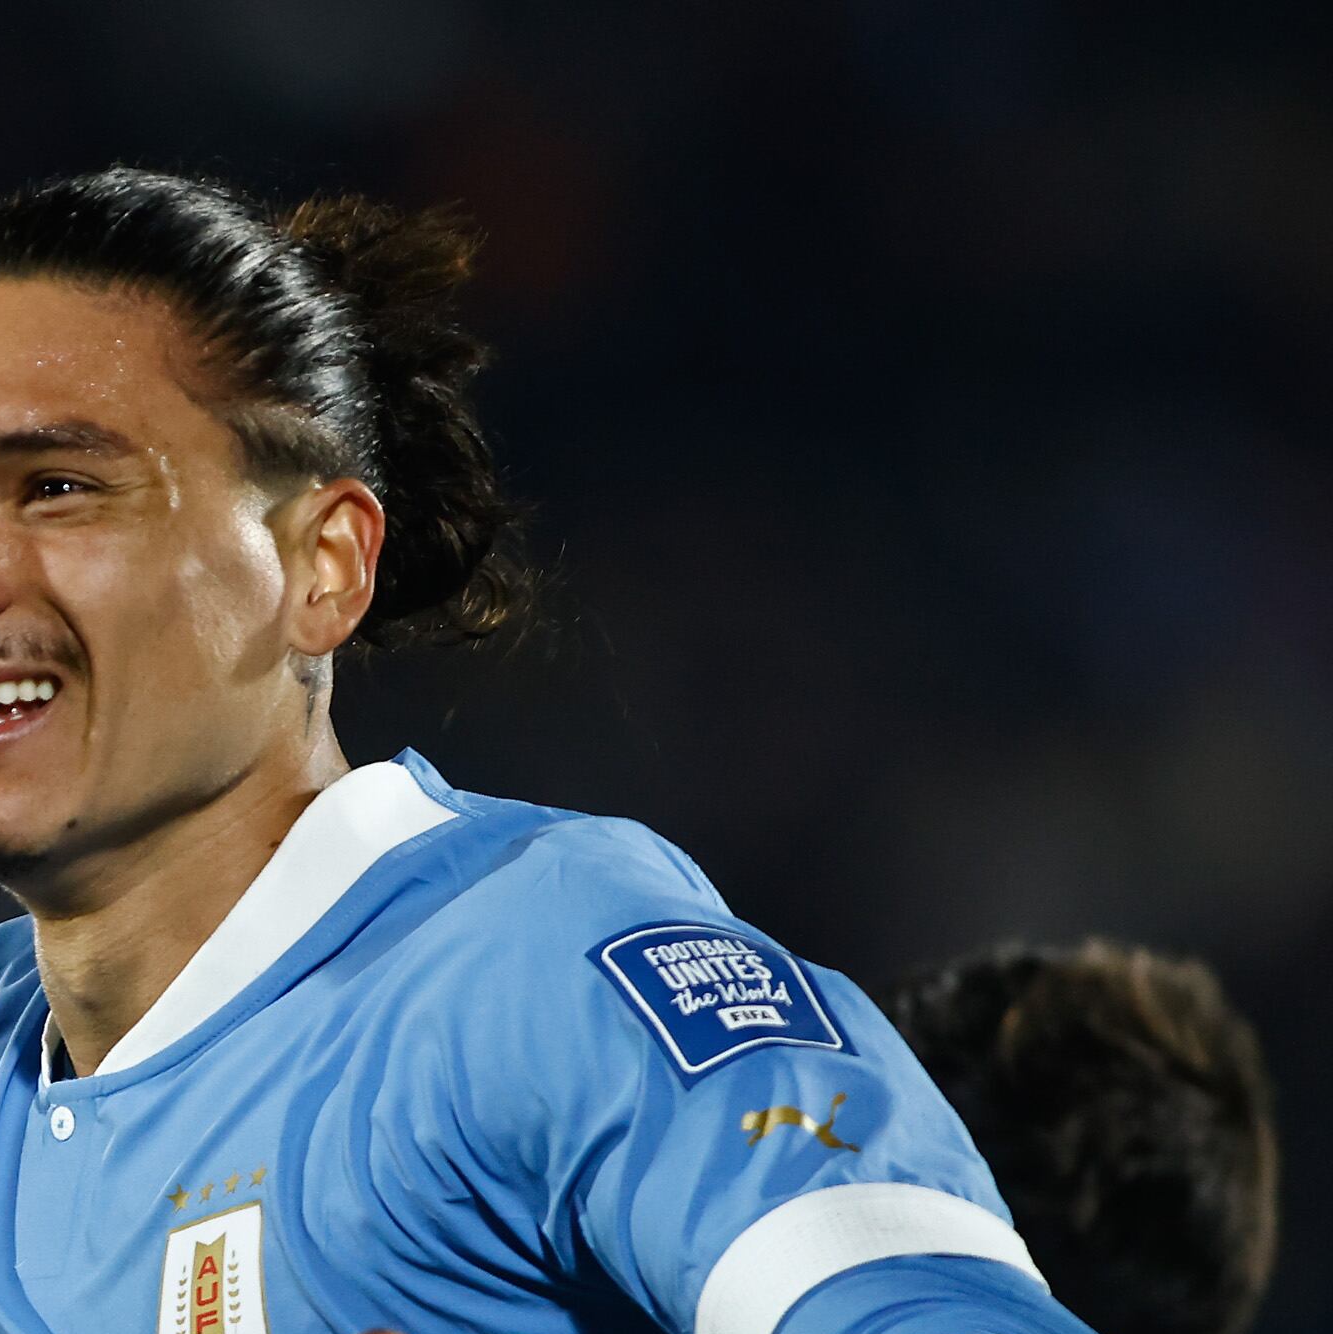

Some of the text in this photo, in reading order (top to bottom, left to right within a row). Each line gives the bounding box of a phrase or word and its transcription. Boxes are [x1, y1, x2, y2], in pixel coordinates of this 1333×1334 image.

[642, 938, 757, 967] FOOTBALL
[657, 954, 773, 990] UNITES
[670, 979, 793, 1016] the World
[729, 1009, 775, 1022] FIFA
